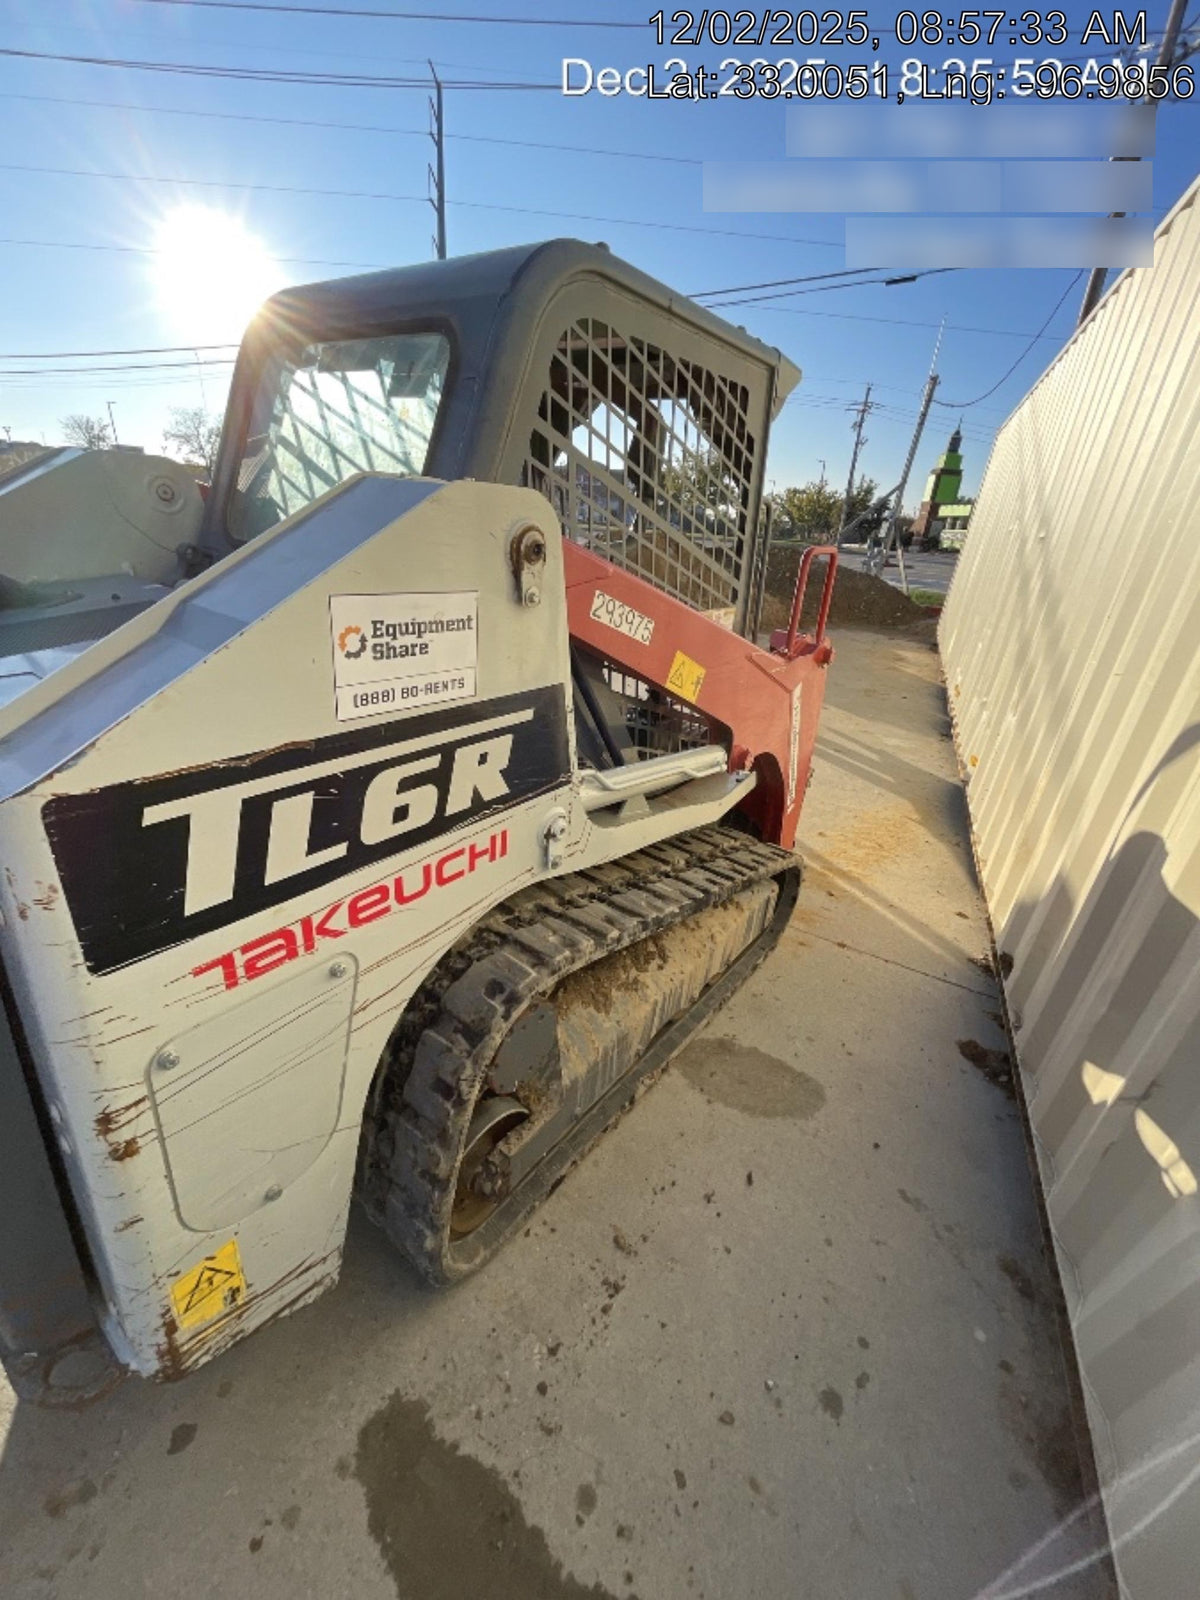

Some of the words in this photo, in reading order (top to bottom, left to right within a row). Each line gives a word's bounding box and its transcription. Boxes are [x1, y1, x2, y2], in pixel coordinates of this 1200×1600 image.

[371, 615, 474, 640] Equipment
[591, 592, 654, 643] 293975
[371, 640, 430, 661] Share
[352, 687, 396, 709] (888)
[141, 708, 535, 917] TL6R
